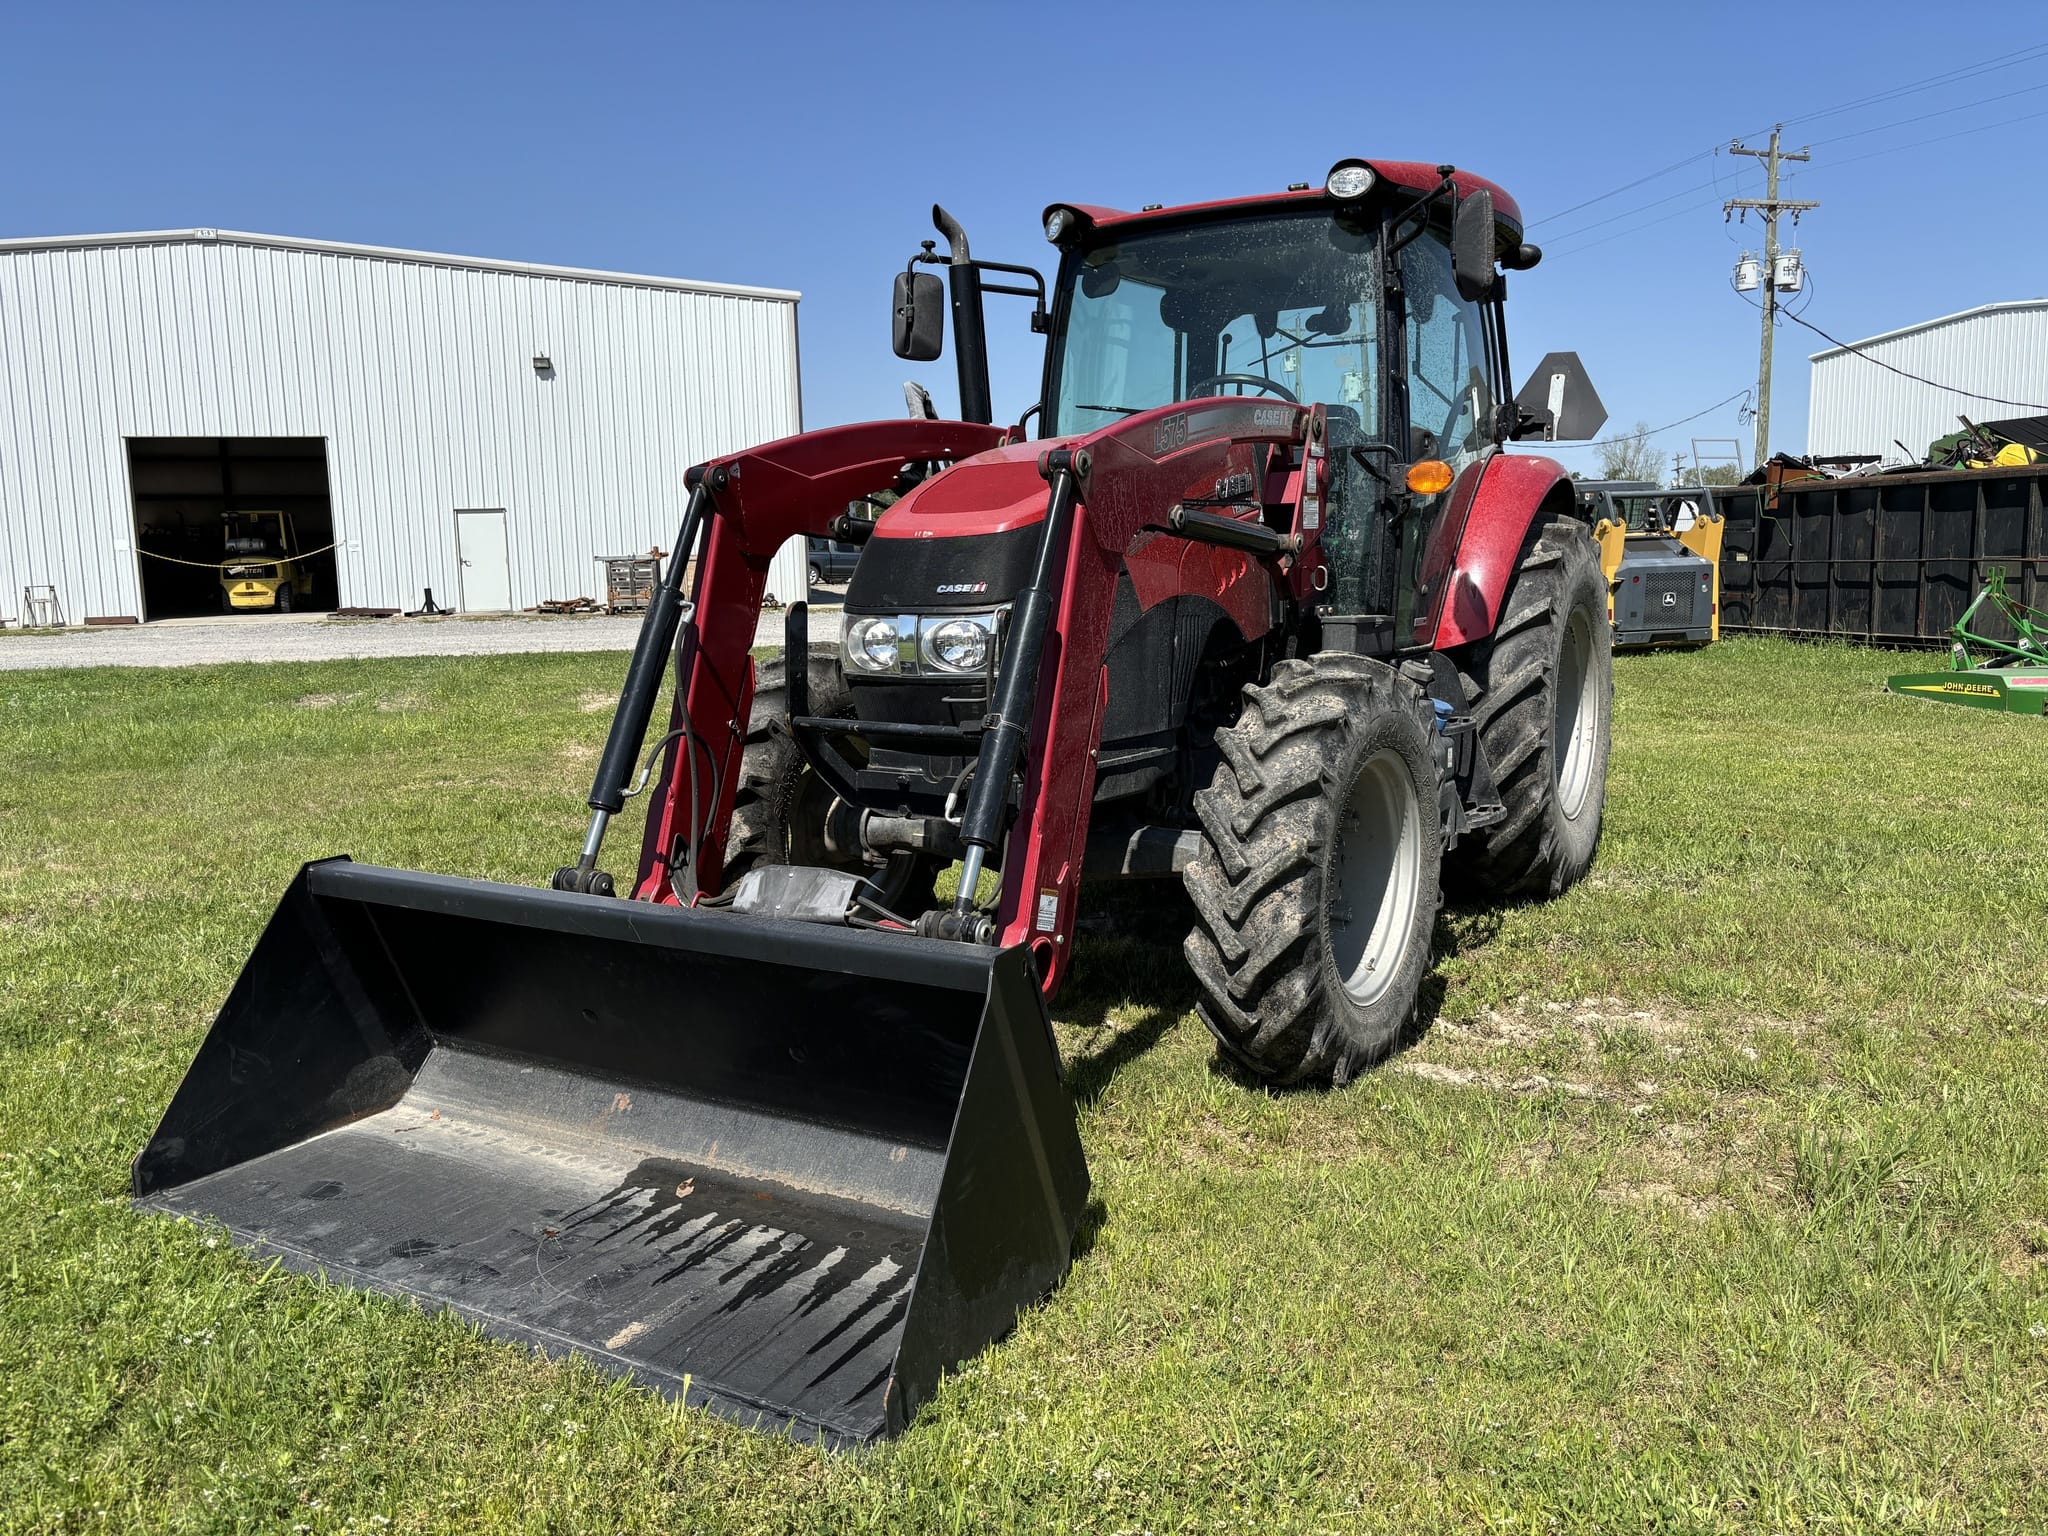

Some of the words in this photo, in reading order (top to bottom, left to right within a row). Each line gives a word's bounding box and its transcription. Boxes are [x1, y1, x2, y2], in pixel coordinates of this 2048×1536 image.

[1154, 412, 1187, 453] L575
[1943, 681, 1964, 691] JOHN
[1967, 683, 1993, 693] DEERE
